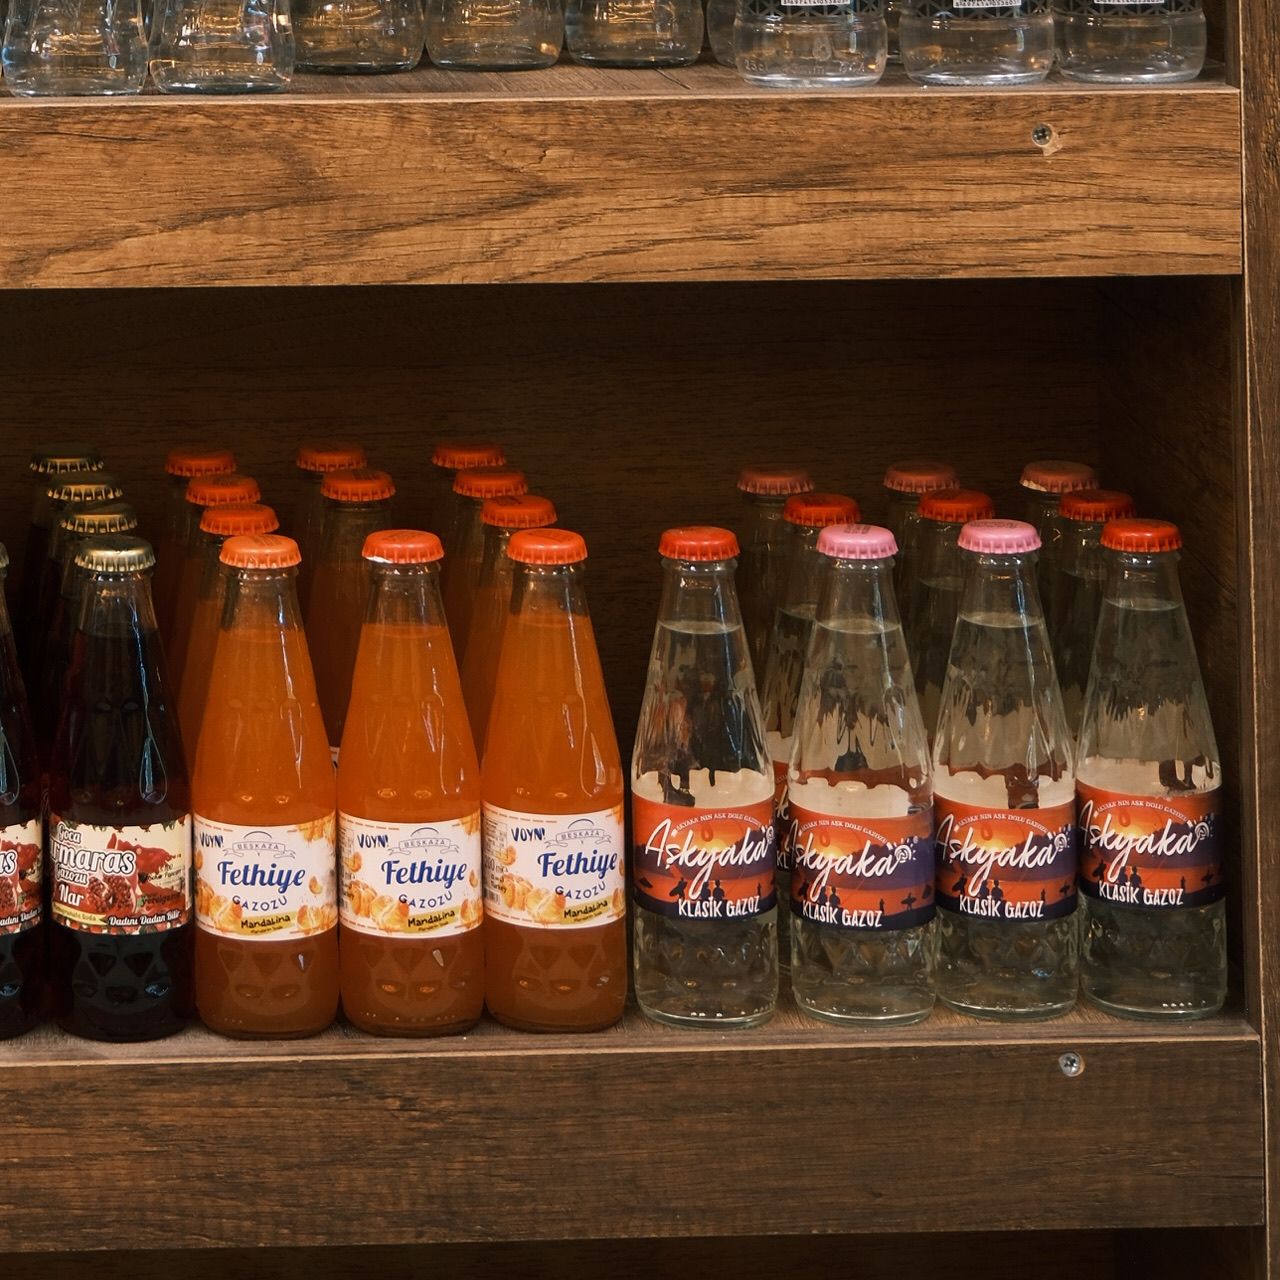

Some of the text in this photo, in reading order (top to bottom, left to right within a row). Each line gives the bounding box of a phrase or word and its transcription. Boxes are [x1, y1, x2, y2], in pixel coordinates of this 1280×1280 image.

[381, 858, 468, 889] Fethiye
[536, 849, 618, 882] Fethiye
[58, 884, 84, 908] Nar
[398, 891, 453, 910] GAZOZU
[554, 880, 606, 899] GAZOZU
[1098, 880, 1184, 906] KLASİK GAZOZ
[563, 899, 608, 919] Mandalina
[678, 895, 760, 918] KLASİK GAZOZ
[802, 900, 882, 928] KLASİK GAZOZ
[959, 894, 1044, 919] KLASİK GAZOZ
[407, 911, 456, 928] Mandalina
